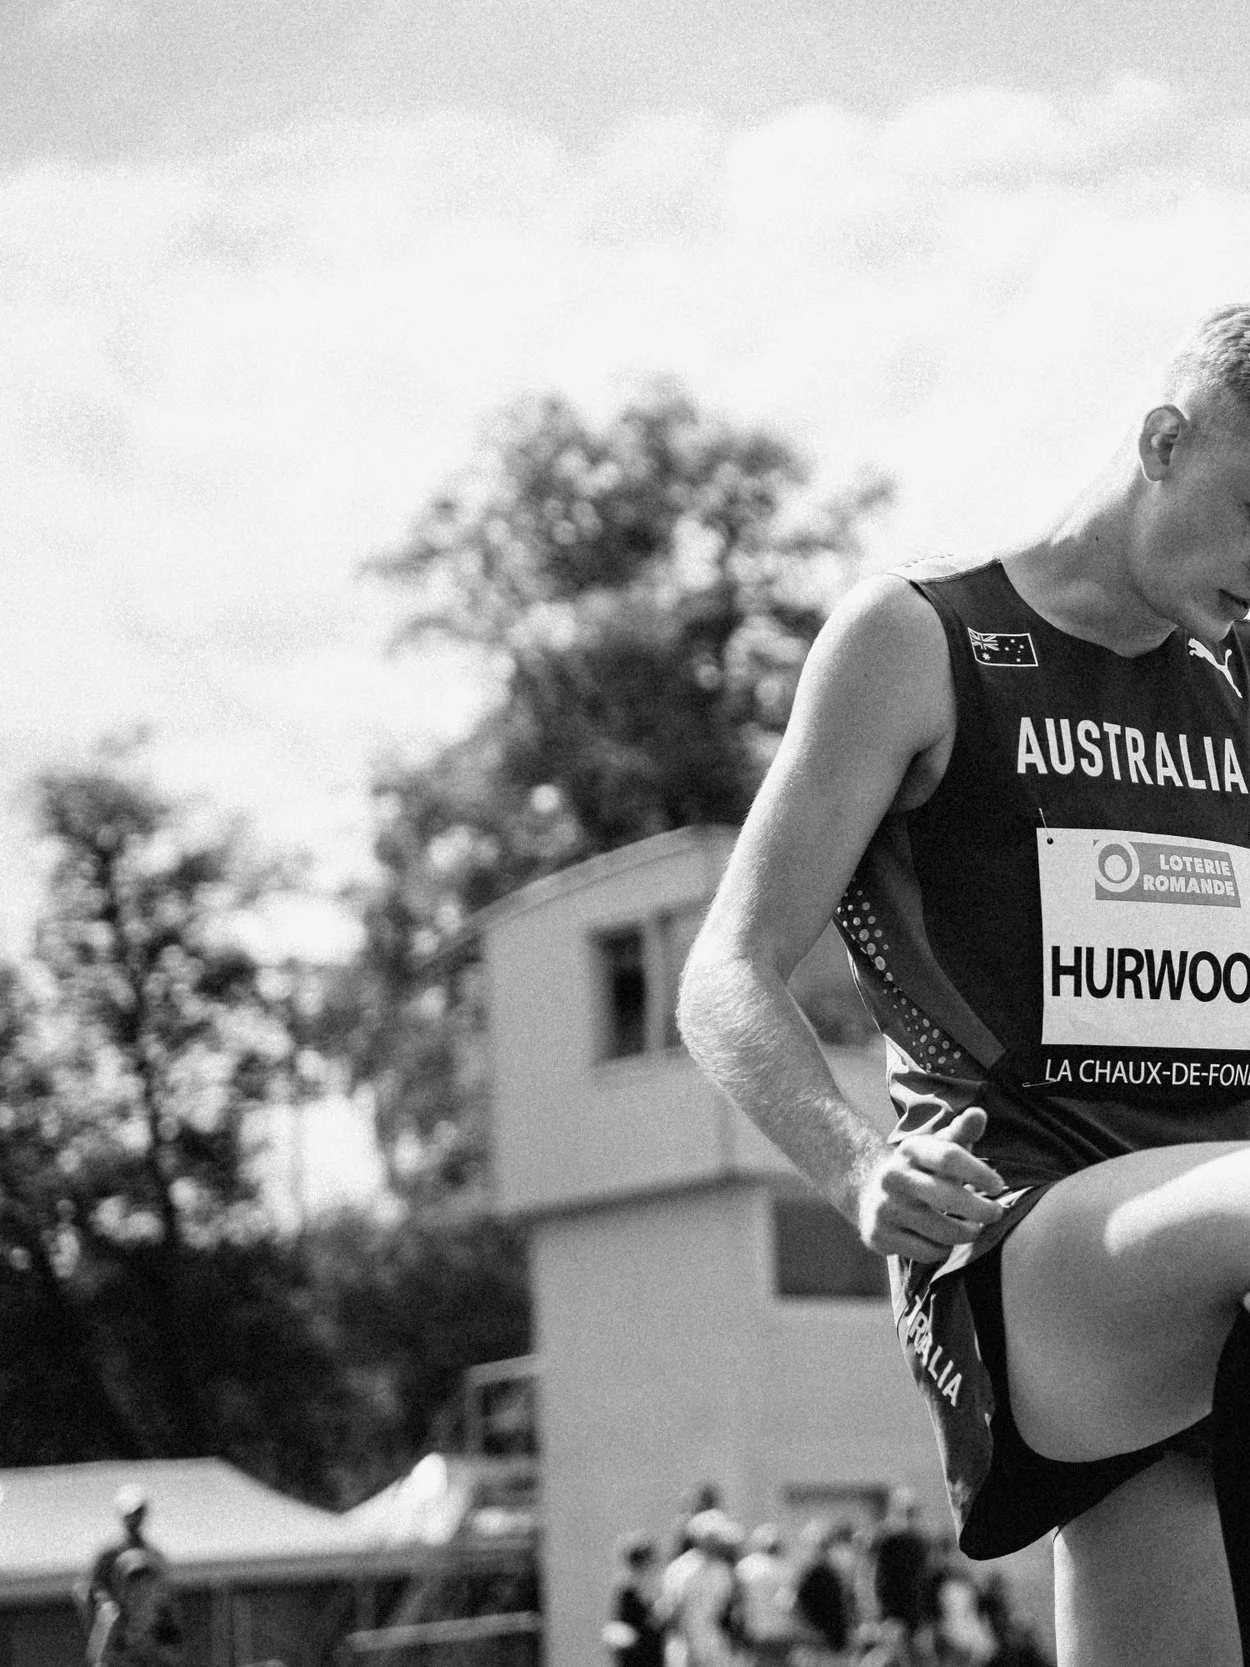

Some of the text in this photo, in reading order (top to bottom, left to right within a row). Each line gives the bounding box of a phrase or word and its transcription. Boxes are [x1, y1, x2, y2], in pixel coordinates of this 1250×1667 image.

[1017, 716, 1249, 794] AUSTRALIA
[1159, 853, 1231, 876] LOTERIE
[1143, 874, 1236, 897] ROMANDE
[1045, 1059, 1073, 1082] LA
